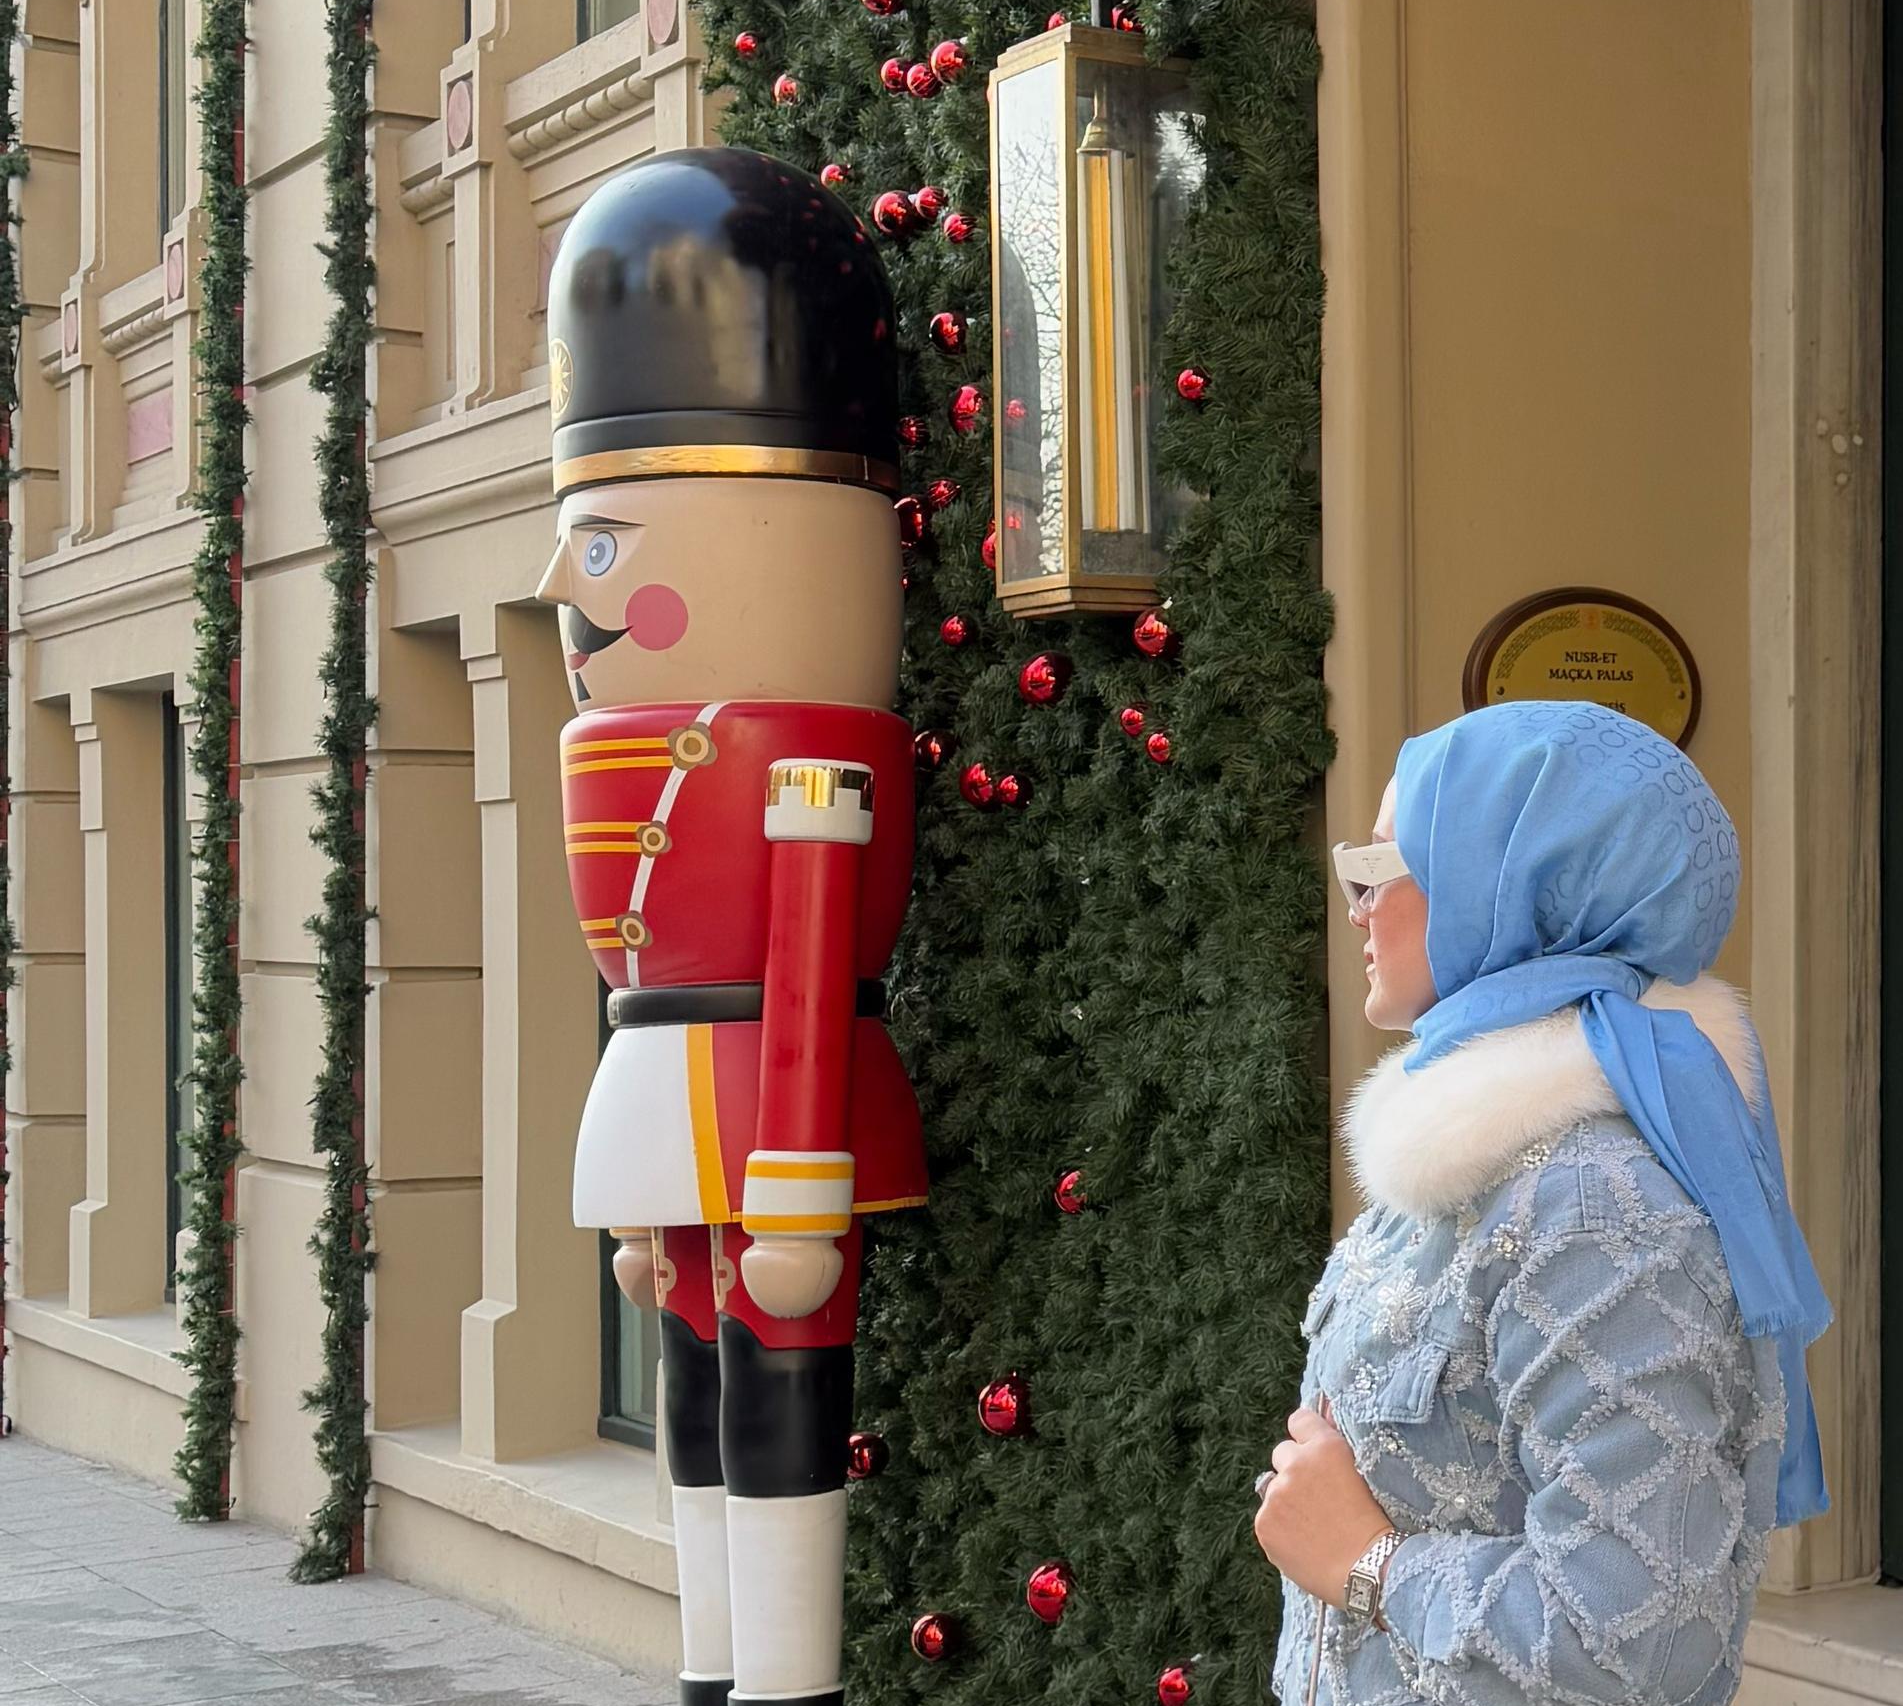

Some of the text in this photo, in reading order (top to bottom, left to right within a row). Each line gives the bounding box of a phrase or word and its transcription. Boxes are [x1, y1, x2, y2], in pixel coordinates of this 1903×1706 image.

[1565, 651, 1617, 663] NUSR-ET
[1549, 668, 1634, 682] MAÇKA PALAS
